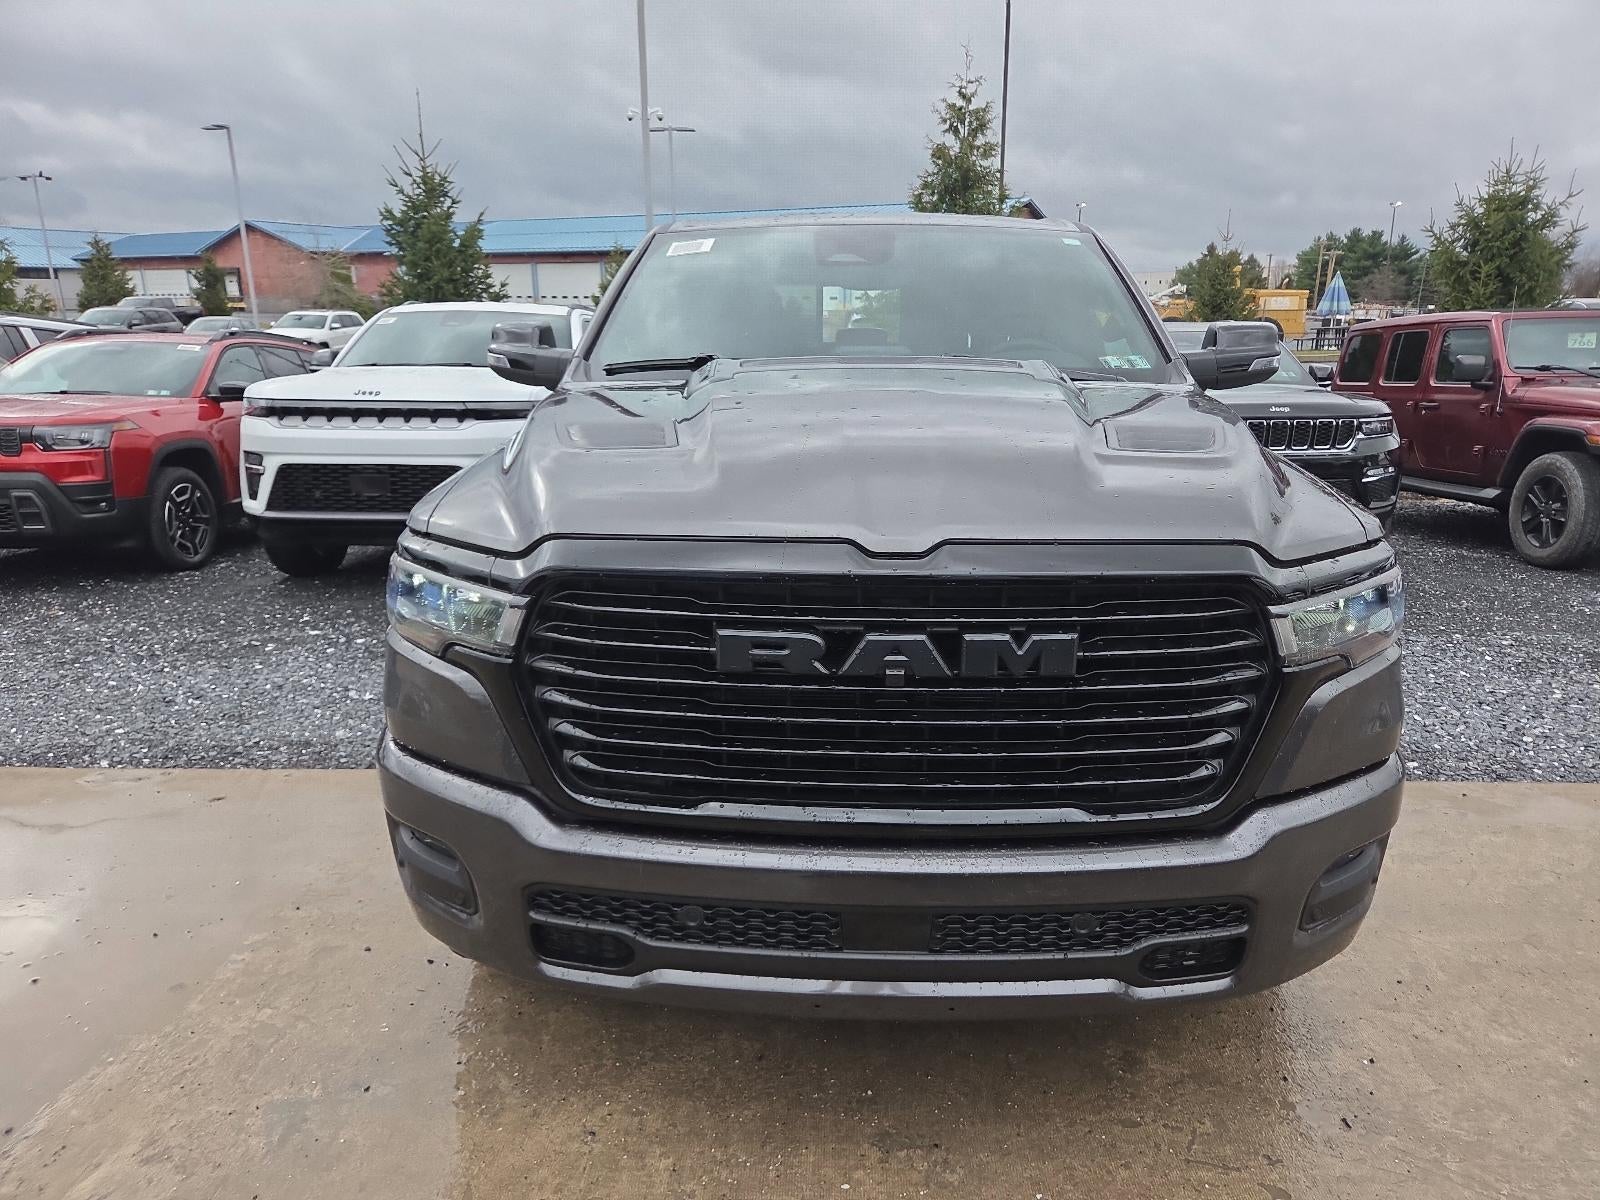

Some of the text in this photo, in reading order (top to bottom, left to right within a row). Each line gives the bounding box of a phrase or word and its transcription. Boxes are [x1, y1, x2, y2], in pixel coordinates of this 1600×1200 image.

[353, 389, 381, 397] Jeep
[1269, 405, 1290, 413] Jeep
[715, 628, 1079, 678] RAM
